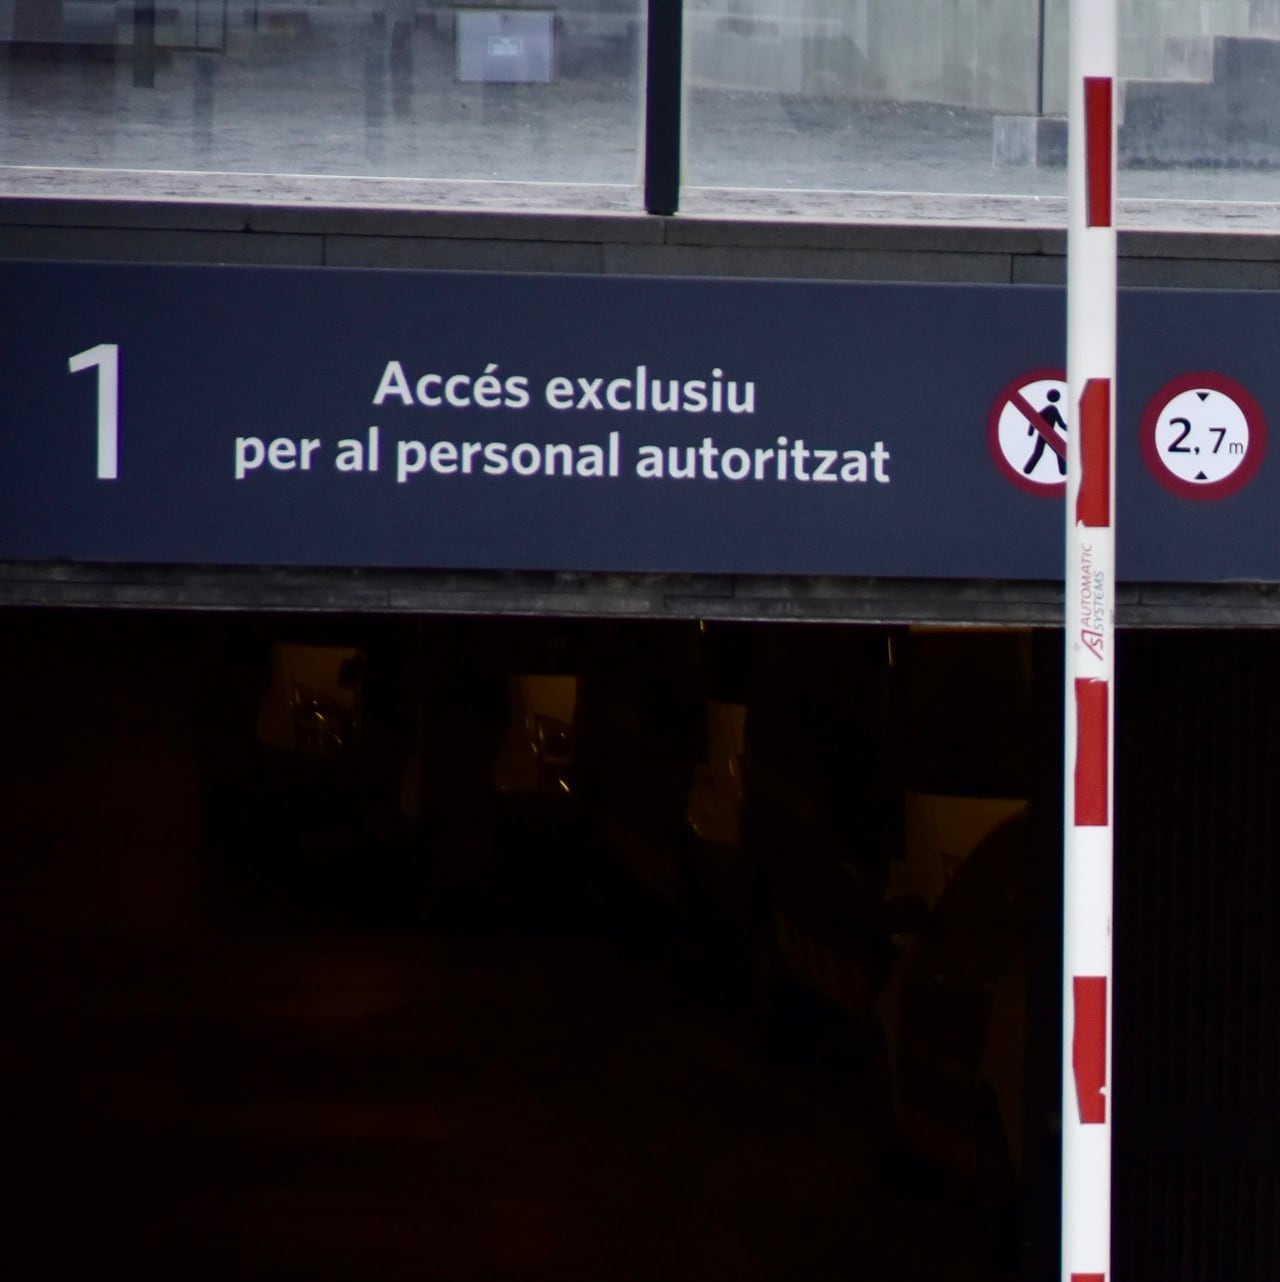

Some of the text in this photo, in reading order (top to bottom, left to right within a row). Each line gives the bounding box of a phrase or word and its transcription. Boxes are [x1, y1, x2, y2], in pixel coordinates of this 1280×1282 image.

[68, 343, 120, 480] 1
[372, 360, 755, 414] Accés exclusiu
[234, 425, 891, 484] per al personal autoritzat
[1080, 543, 1093, 629] AUTOMATIC
[1093, 570, 1105, 632] SYSTEMS
